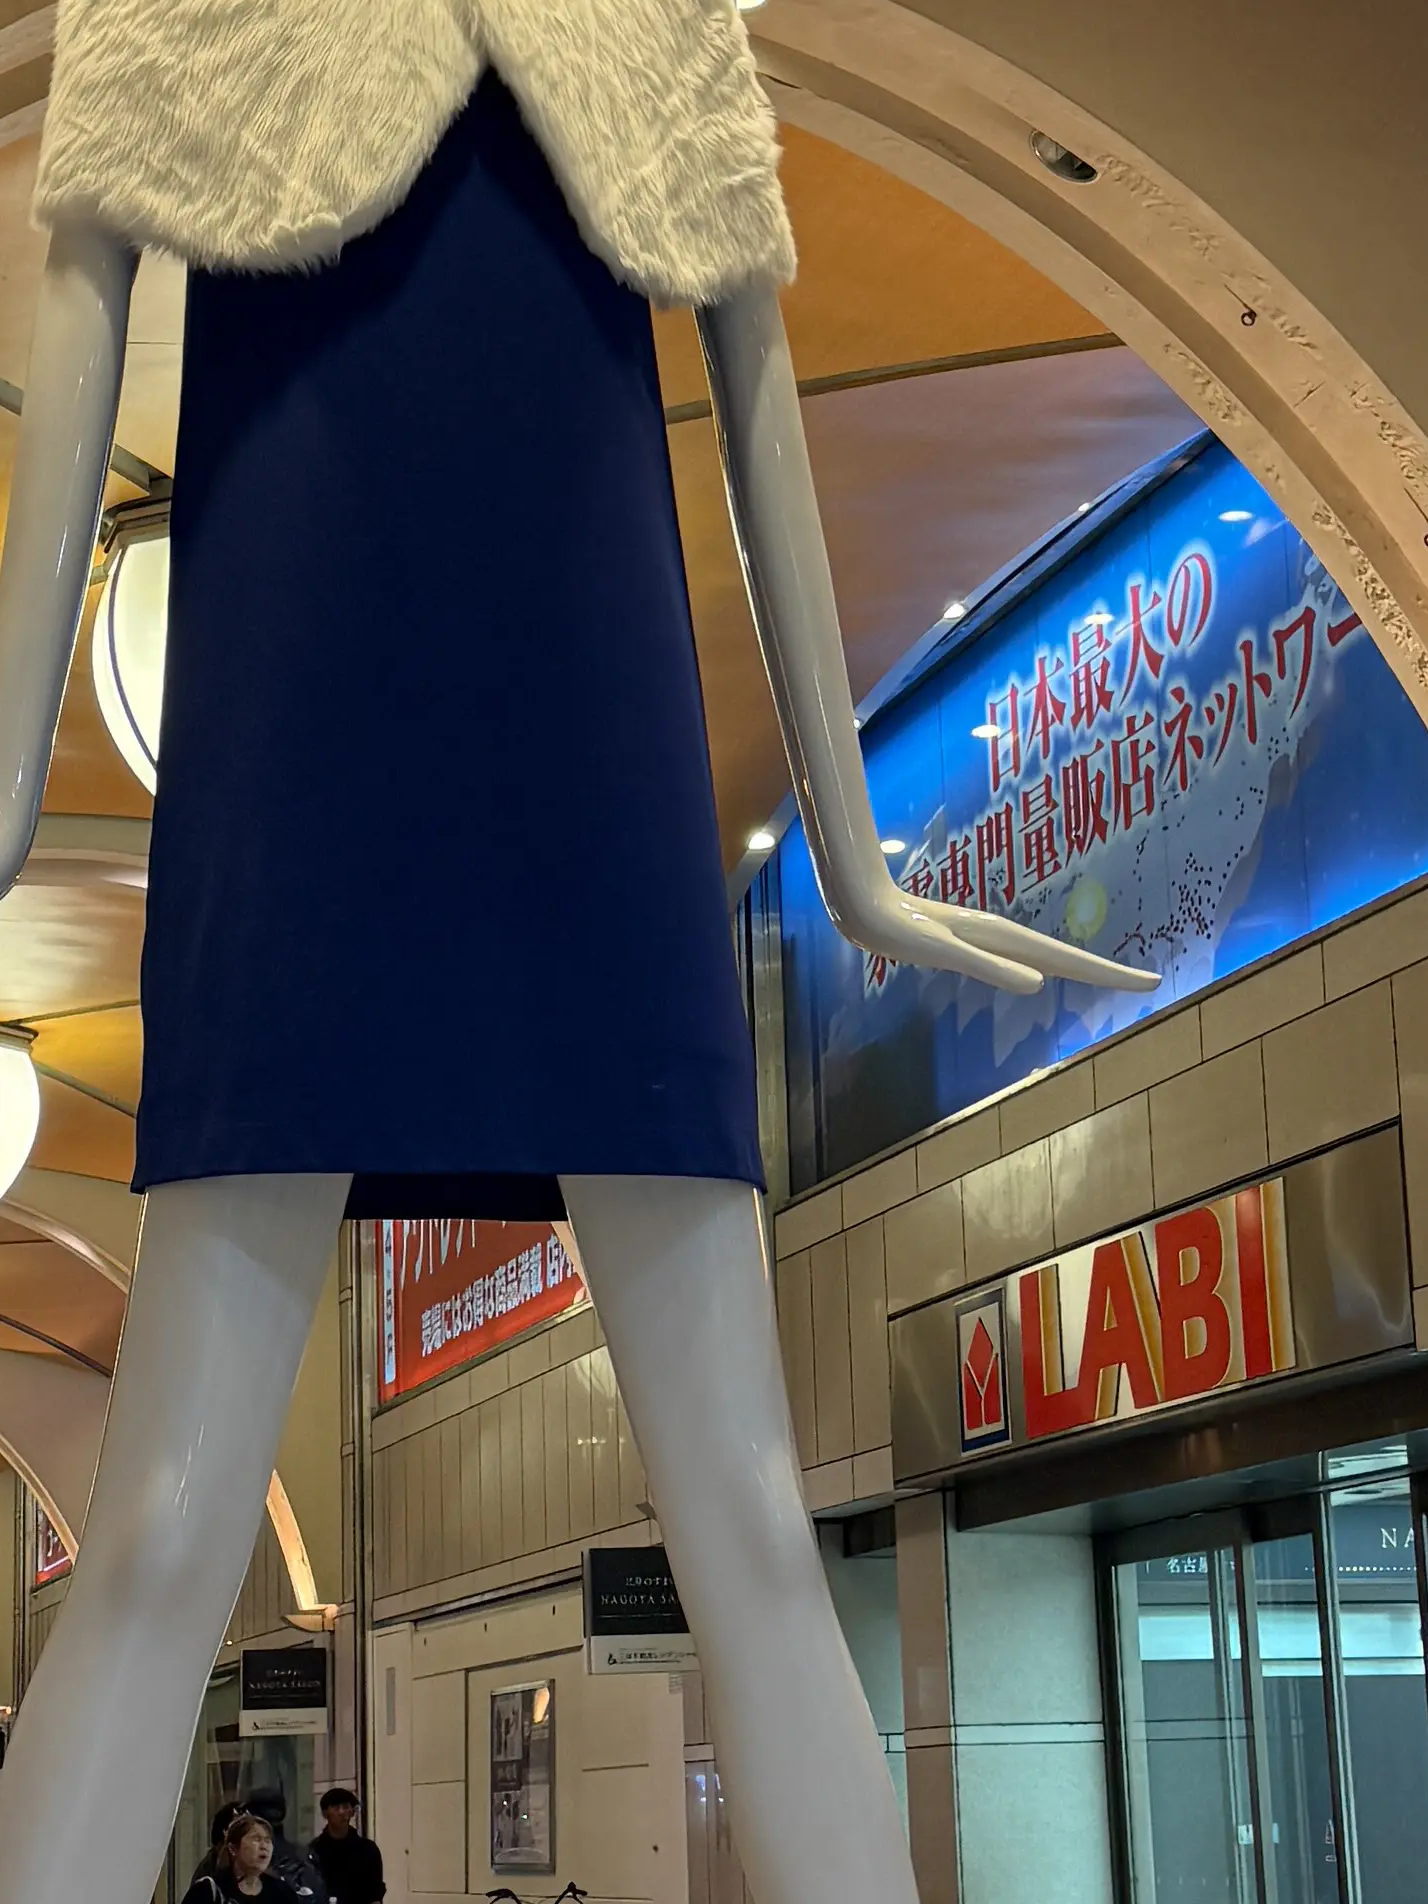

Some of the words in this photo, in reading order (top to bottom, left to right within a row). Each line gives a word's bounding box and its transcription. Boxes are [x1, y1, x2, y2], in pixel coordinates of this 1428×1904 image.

[866, 607, 1363, 988] 専門量販店ネットワー
[988, 552, 1213, 793] 日本最大の
[1019, 1181, 1284, 1439] LABI
